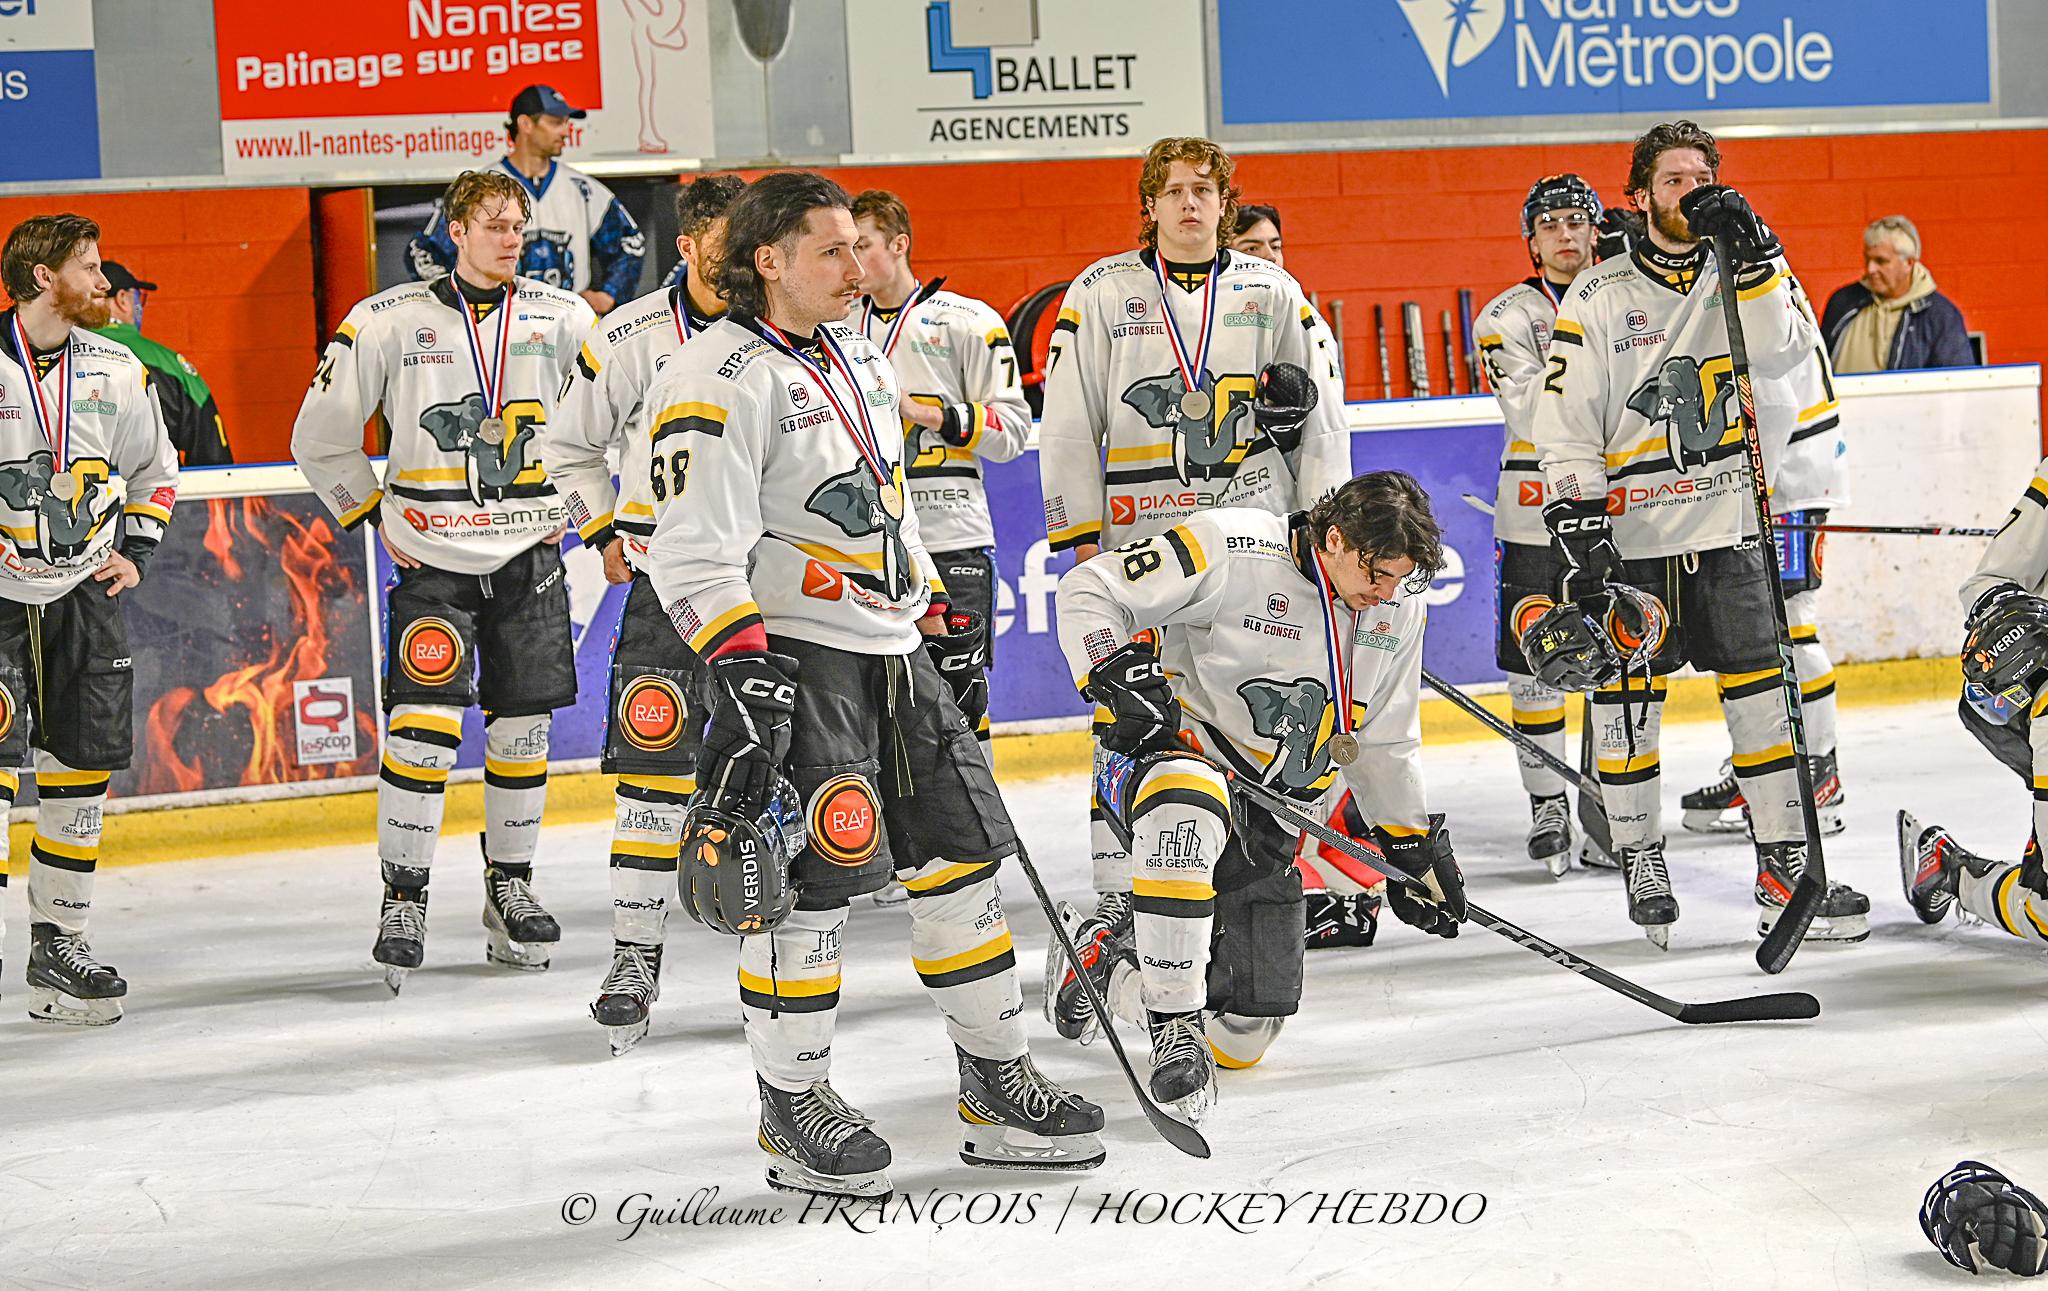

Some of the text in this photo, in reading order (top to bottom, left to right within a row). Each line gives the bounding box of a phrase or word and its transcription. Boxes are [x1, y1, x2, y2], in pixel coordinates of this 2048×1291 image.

[407, 0, 583, 39] Nantes
[236, 37, 584, 92] Patinage sur glace
[1515, 18, 1834, 100] Métropole
[996, 55, 1137, 93] BALLET
[930, 113, 1129, 142] AGENCEMENTS
[1652, 250, 1700, 267] CCM
[1082, 267, 1105, 287] BTP
[519, 289, 544, 299] BTP
[1579, 277, 1600, 301] BTP
[370, 298, 396, 312] BTP
[398, 290, 431, 301] SAVOIE
[607, 309, 671, 344] BTP SAVOIE
[1129, 325, 1164, 336] CONSEIL
[72, 342, 96, 354] BTP
[1614, 333, 1667, 354] BLB CONSEIL
[403, 354, 454, 367] BLB CONSEIL
[717, 352, 743, 379] BTP
[1000, 356, 1015, 388] 7
[798, 410, 835, 430] CONSEIL
[1748, 428, 1765, 496] TACKS
[1226, 536, 1256, 549] BTP
[1733, 538, 1761, 551] CCM
[535, 566, 562, 594] CCM
[949, 566, 985, 576] CCM
[1269, 598, 1287, 612] BLB
[951, 616, 968, 624] CCM
[1243, 618, 1301, 641] BLB CONSEIL
[415, 643, 448, 660] RAF
[1085, 637, 1116, 651] Chambéry
[2011, 658, 2035, 681] CCM
[634, 703, 669, 723] RAF
[387, 818, 434, 833] owayo
[635, 820, 672, 833] GESTION
[832, 807, 870, 833] RAF
[1391, 841, 1419, 850] CCM
[1145, 857, 1209, 870] ISIS GESTION
[739, 838, 759, 911] VERDIS
[779, 865, 787, 898] CCM
[974, 914, 994, 931] ISIS
[1487, 920, 1591, 973] CCM
[804, 952, 823, 965] ISIS
[1143, 954, 1193, 970] owayo
[964, 1089, 1007, 1123] CCM
